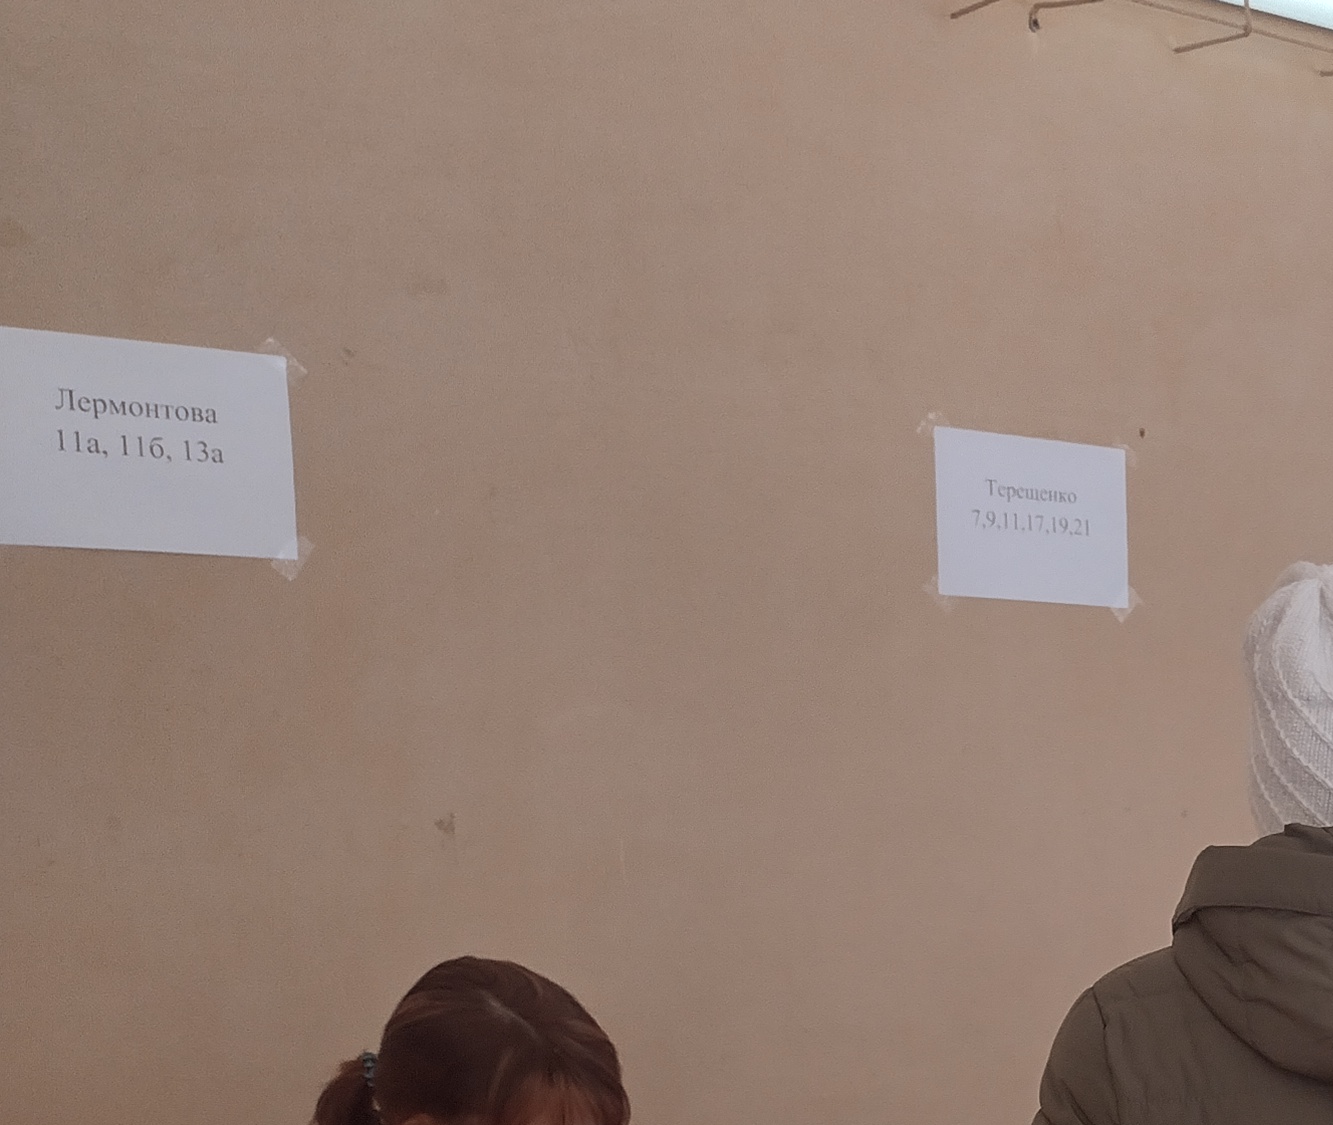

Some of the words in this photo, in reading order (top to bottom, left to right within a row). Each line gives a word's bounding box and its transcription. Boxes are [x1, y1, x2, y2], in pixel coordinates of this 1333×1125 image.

[54, 387, 219, 424] Лермонтова
[56, 428, 108, 458] 11а,
[121, 435, 172, 463] 11б,
[183, 440, 224, 464] 13а
[985, 478, 1078, 504] Терещенко
